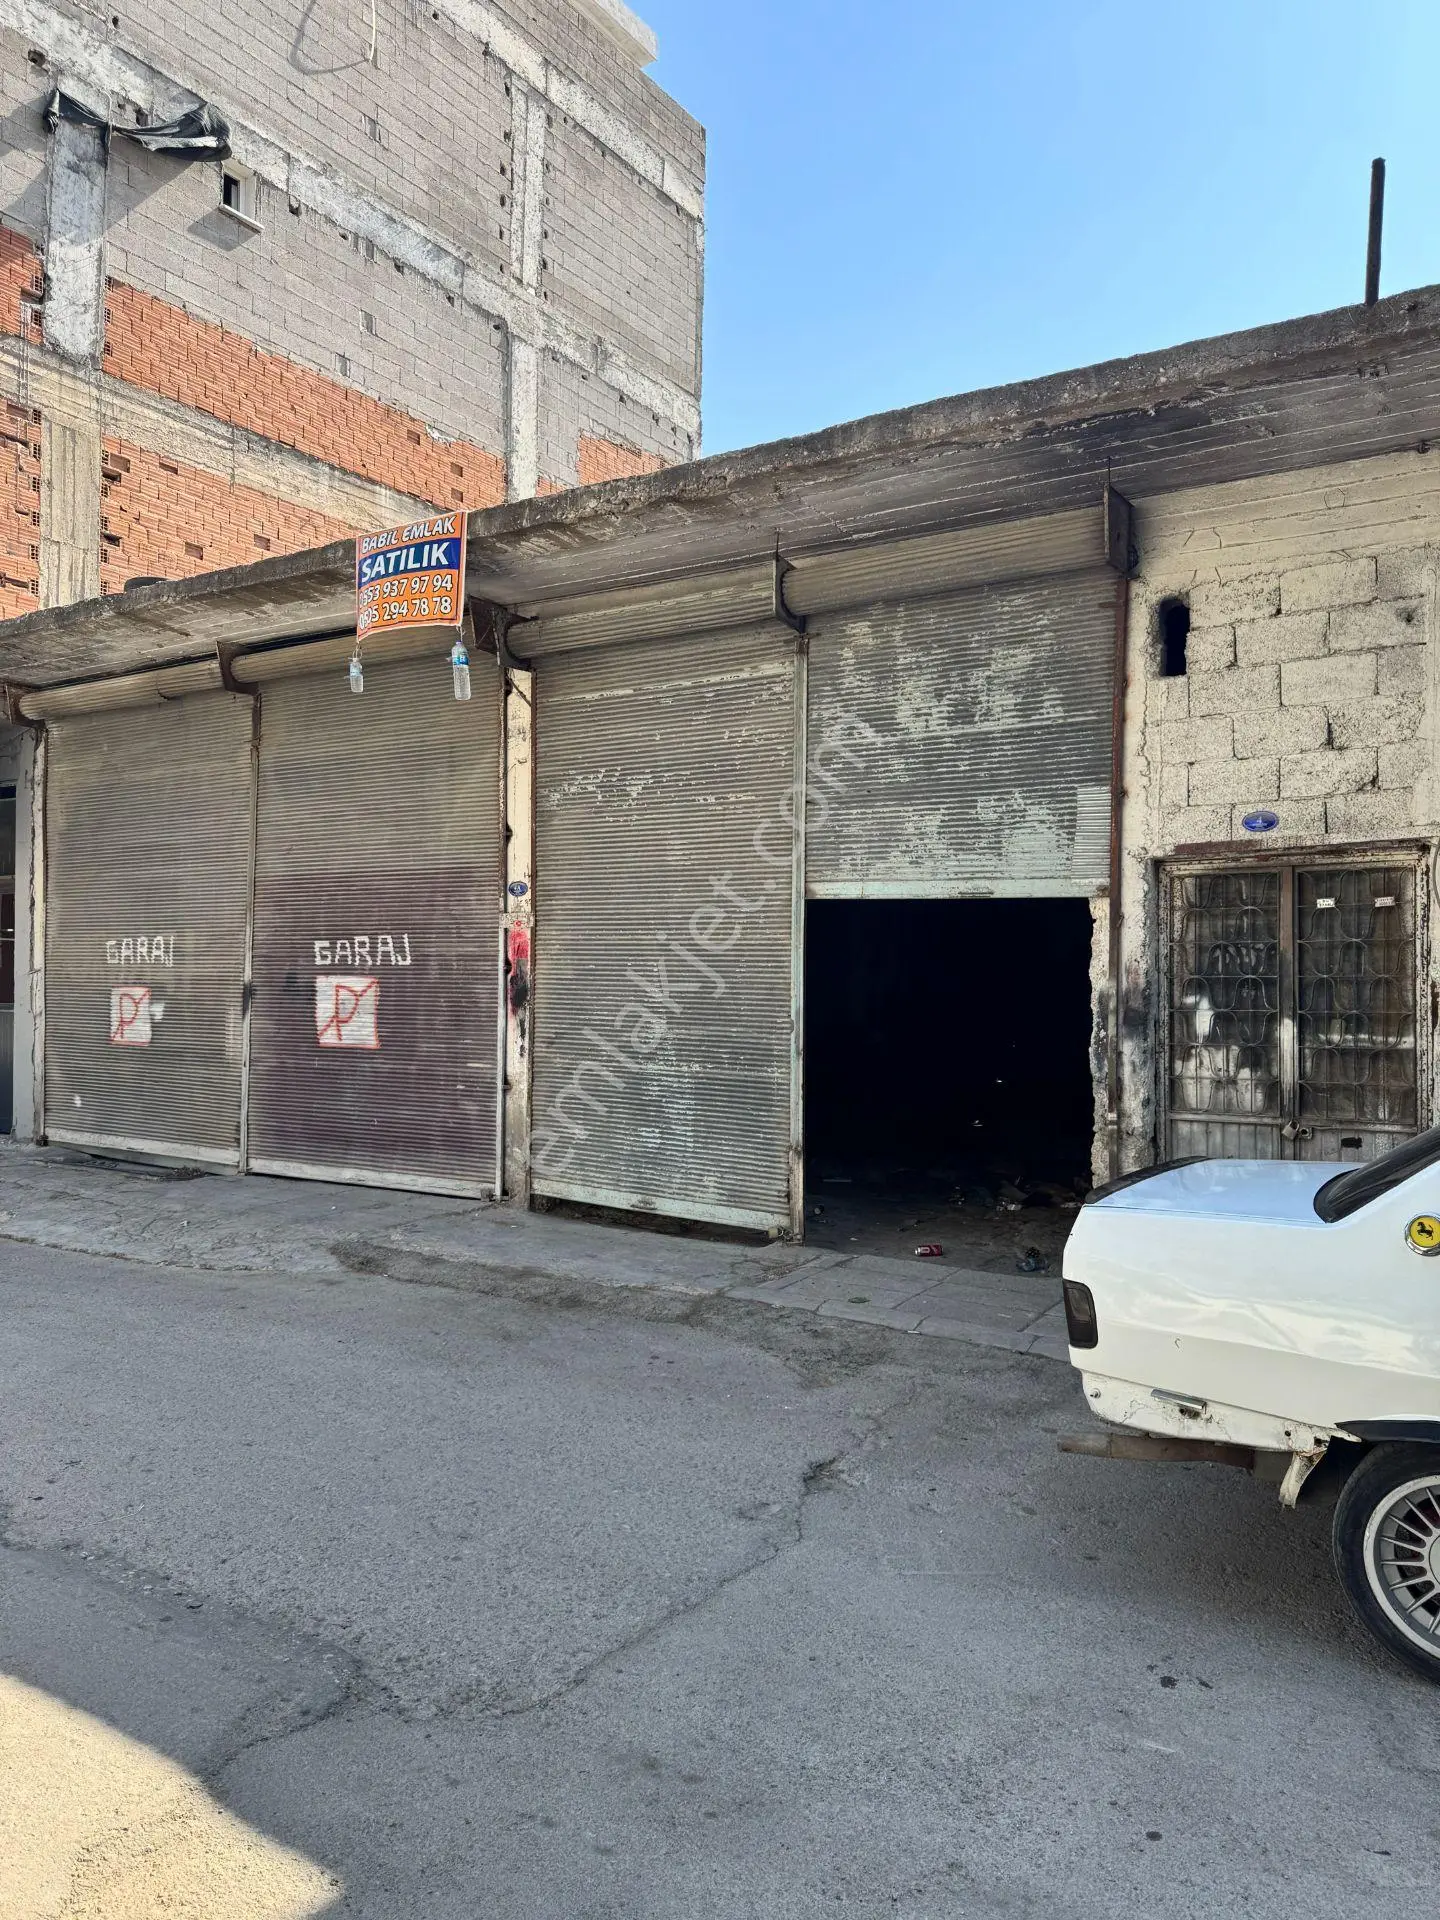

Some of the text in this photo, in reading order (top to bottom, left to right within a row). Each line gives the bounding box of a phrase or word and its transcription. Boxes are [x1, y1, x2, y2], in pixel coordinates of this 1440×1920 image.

[401, 516, 456, 542] EMLAK
[361, 542, 450, 582] SATILIK
[382, 578, 408, 599] 937
[411, 576, 430, 594] 97
[432, 574, 453, 593] 94
[382, 600, 409, 622] 294
[412, 598, 430, 617] 78
[432, 596, 452, 614] 78
[313, 933, 412, 966] GARAJ
